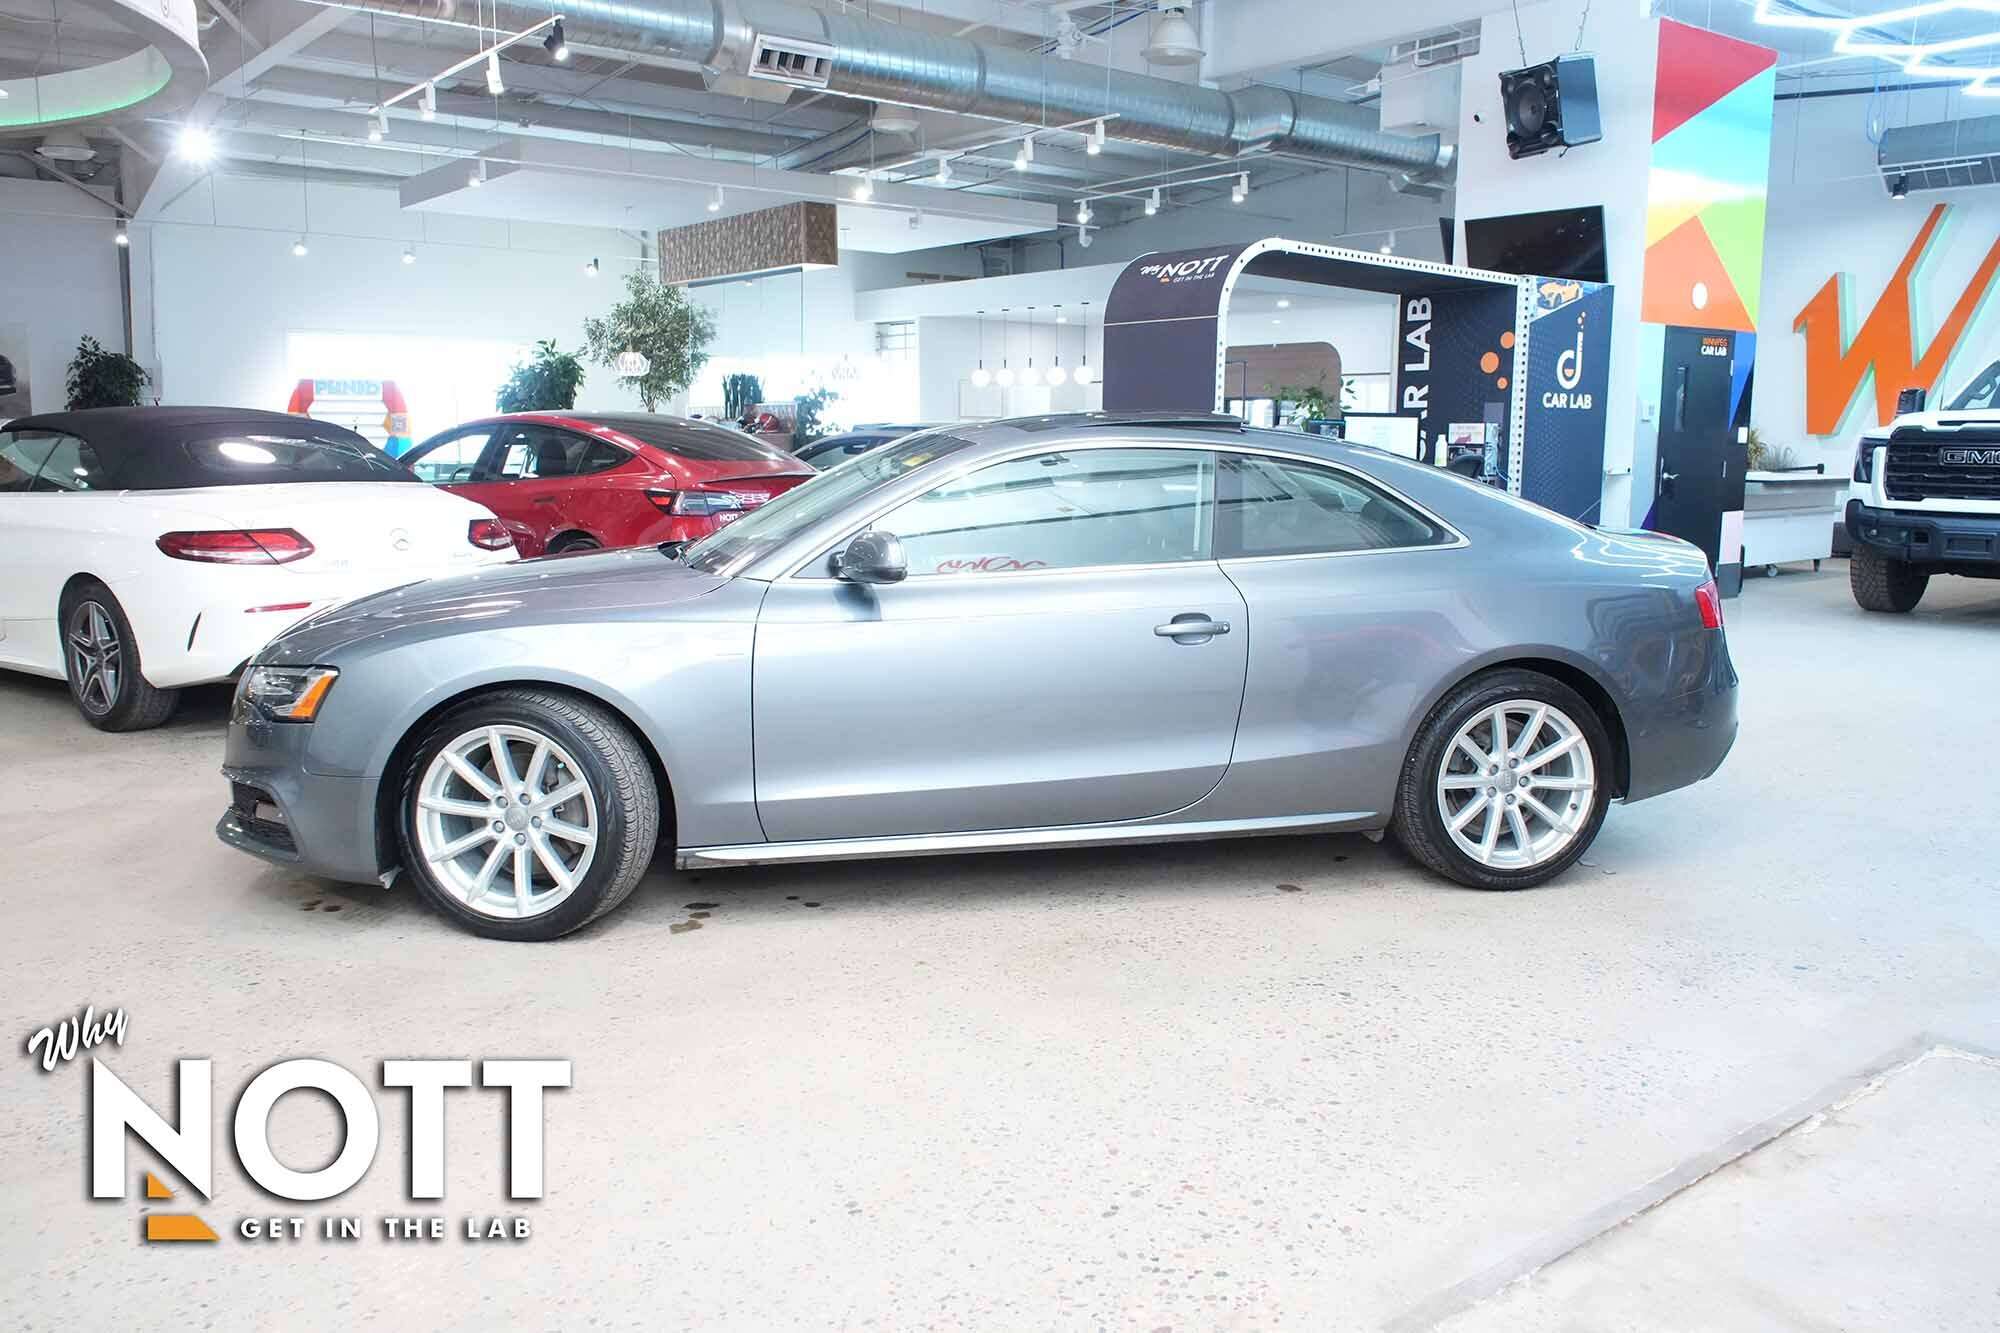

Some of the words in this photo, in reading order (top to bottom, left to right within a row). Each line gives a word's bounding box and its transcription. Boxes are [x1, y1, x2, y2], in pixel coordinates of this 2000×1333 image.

[1157, 254, 1230, 279] NOTT
[1405, 297, 1432, 372] LAB
[1542, 391, 1568, 409] CAR
[1569, 392, 1592, 410] LAB
[1943, 450, 2000, 464] GM
